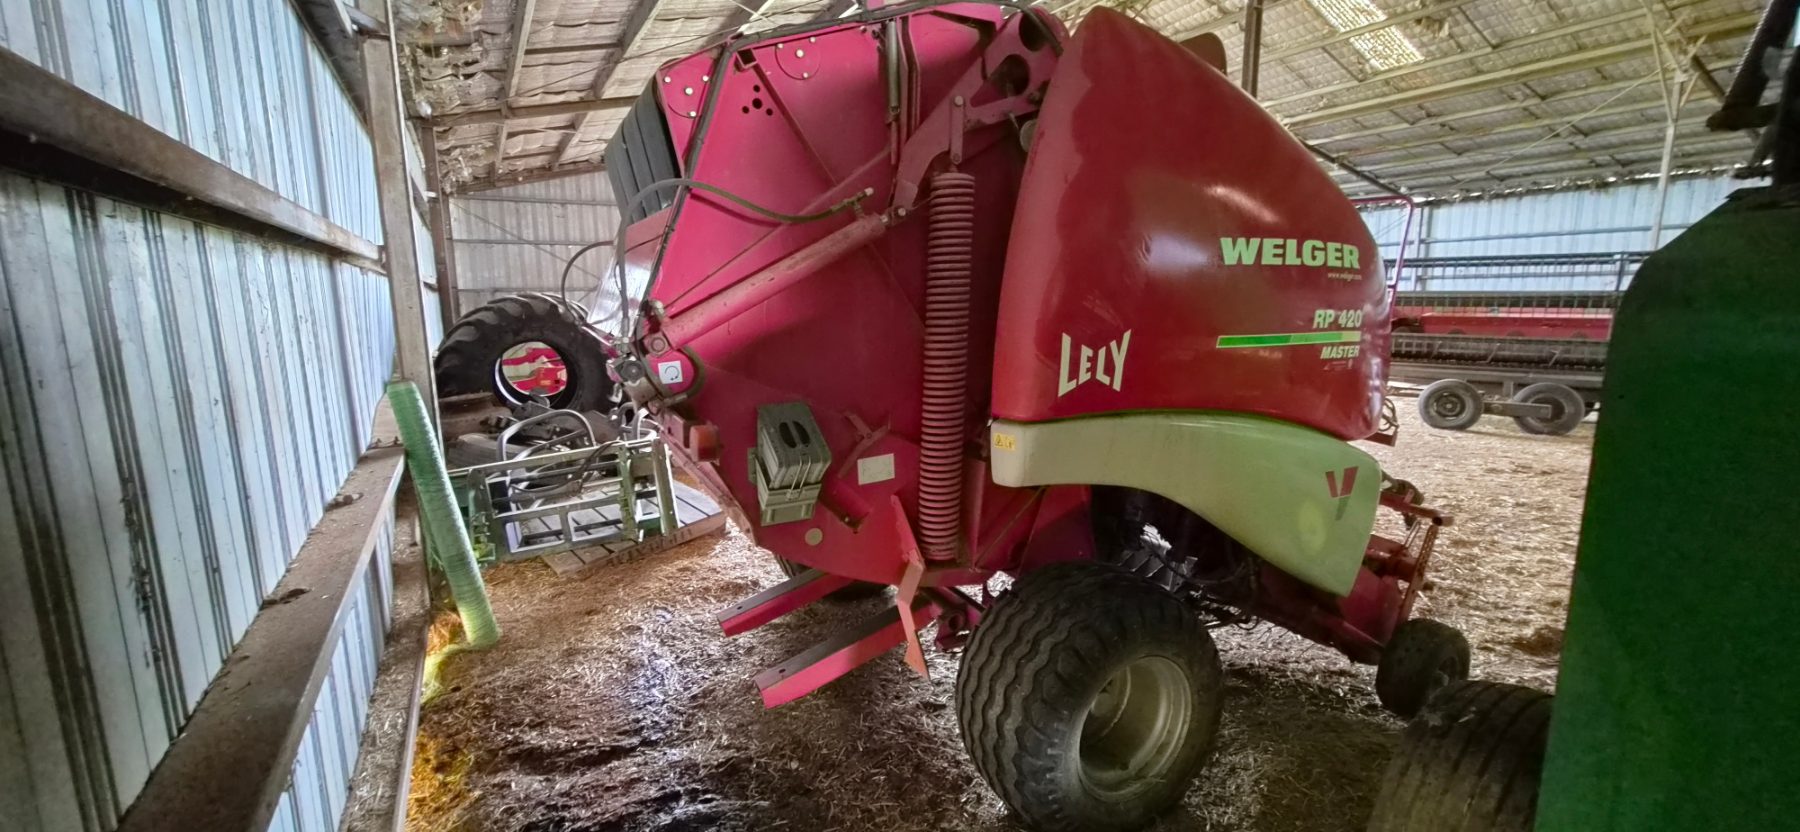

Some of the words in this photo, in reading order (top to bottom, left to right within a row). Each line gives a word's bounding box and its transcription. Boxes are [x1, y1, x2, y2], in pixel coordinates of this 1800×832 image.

[1220, 237, 1360, 269] WELGER
[1313, 309, 1335, 329] RP
[1338, 309, 1362, 328] 420
[1058, 329, 1132, 397] LELY
[1320, 345, 1360, 359] MASTER
